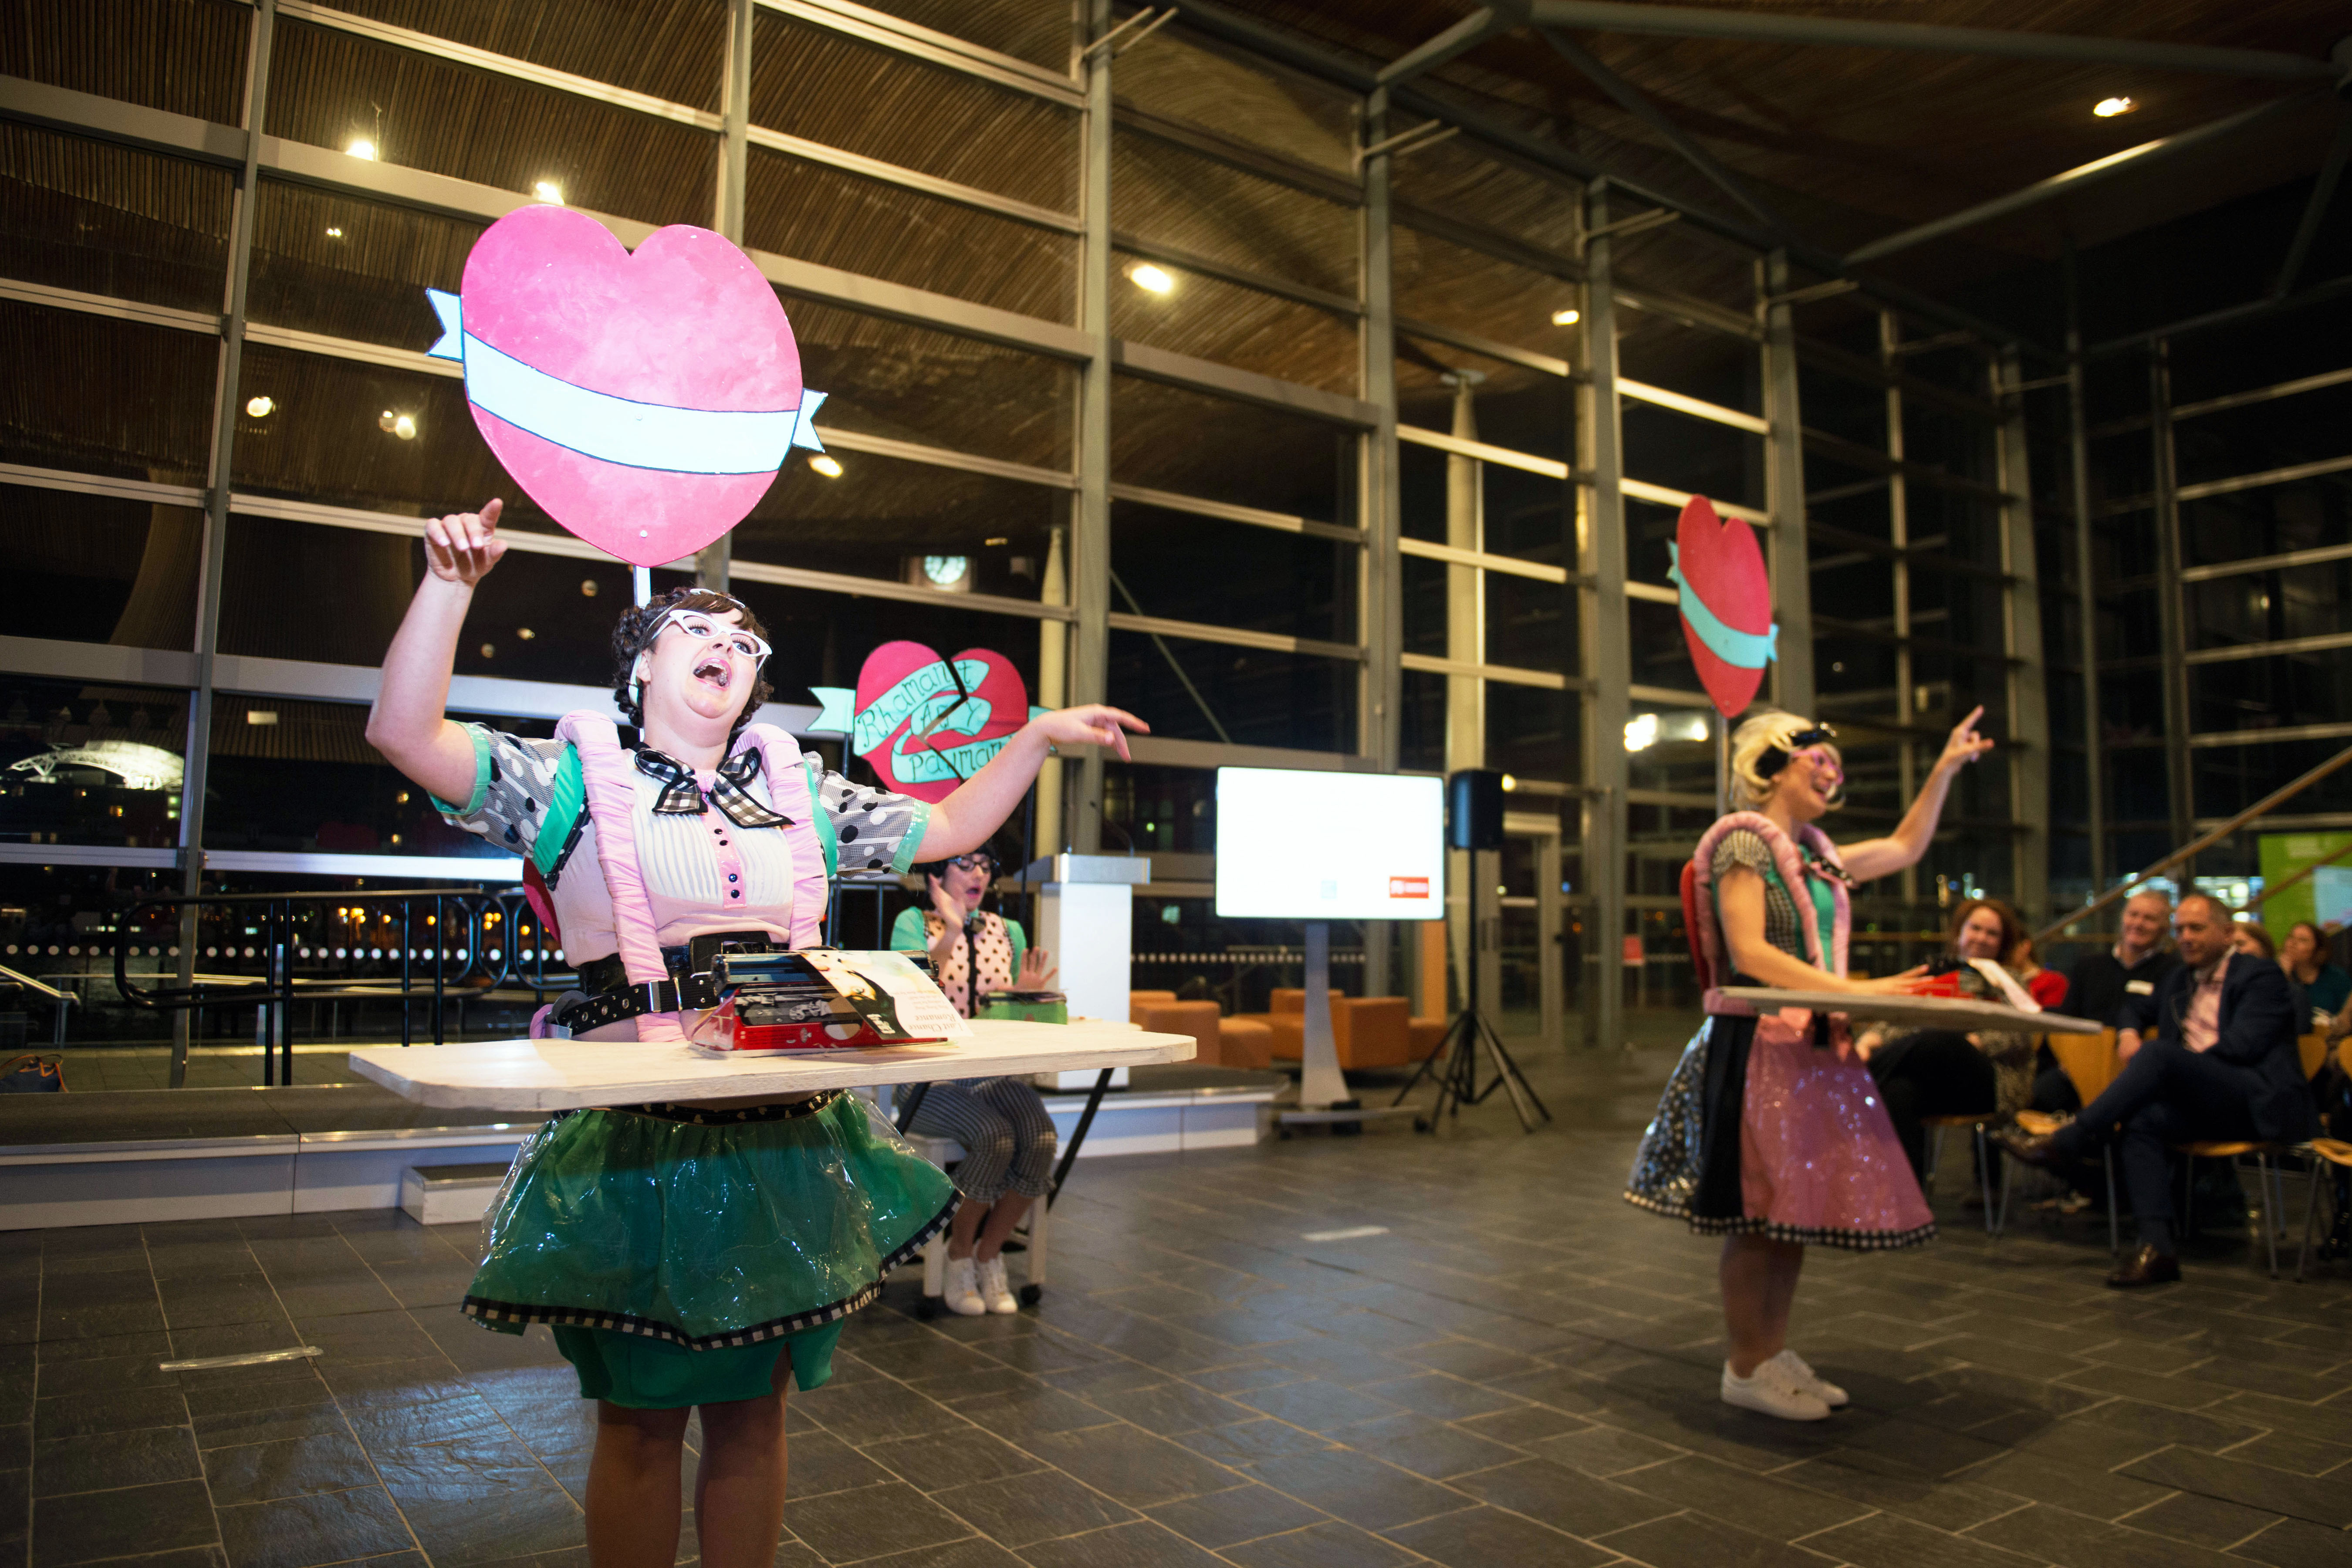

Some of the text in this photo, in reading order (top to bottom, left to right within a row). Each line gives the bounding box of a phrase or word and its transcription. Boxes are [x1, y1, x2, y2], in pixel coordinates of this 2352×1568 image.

[857, 660, 972, 748] Rhamant
[916, 1013, 956, 1022] Romance
[909, 1022, 963, 1032] Last Chance
